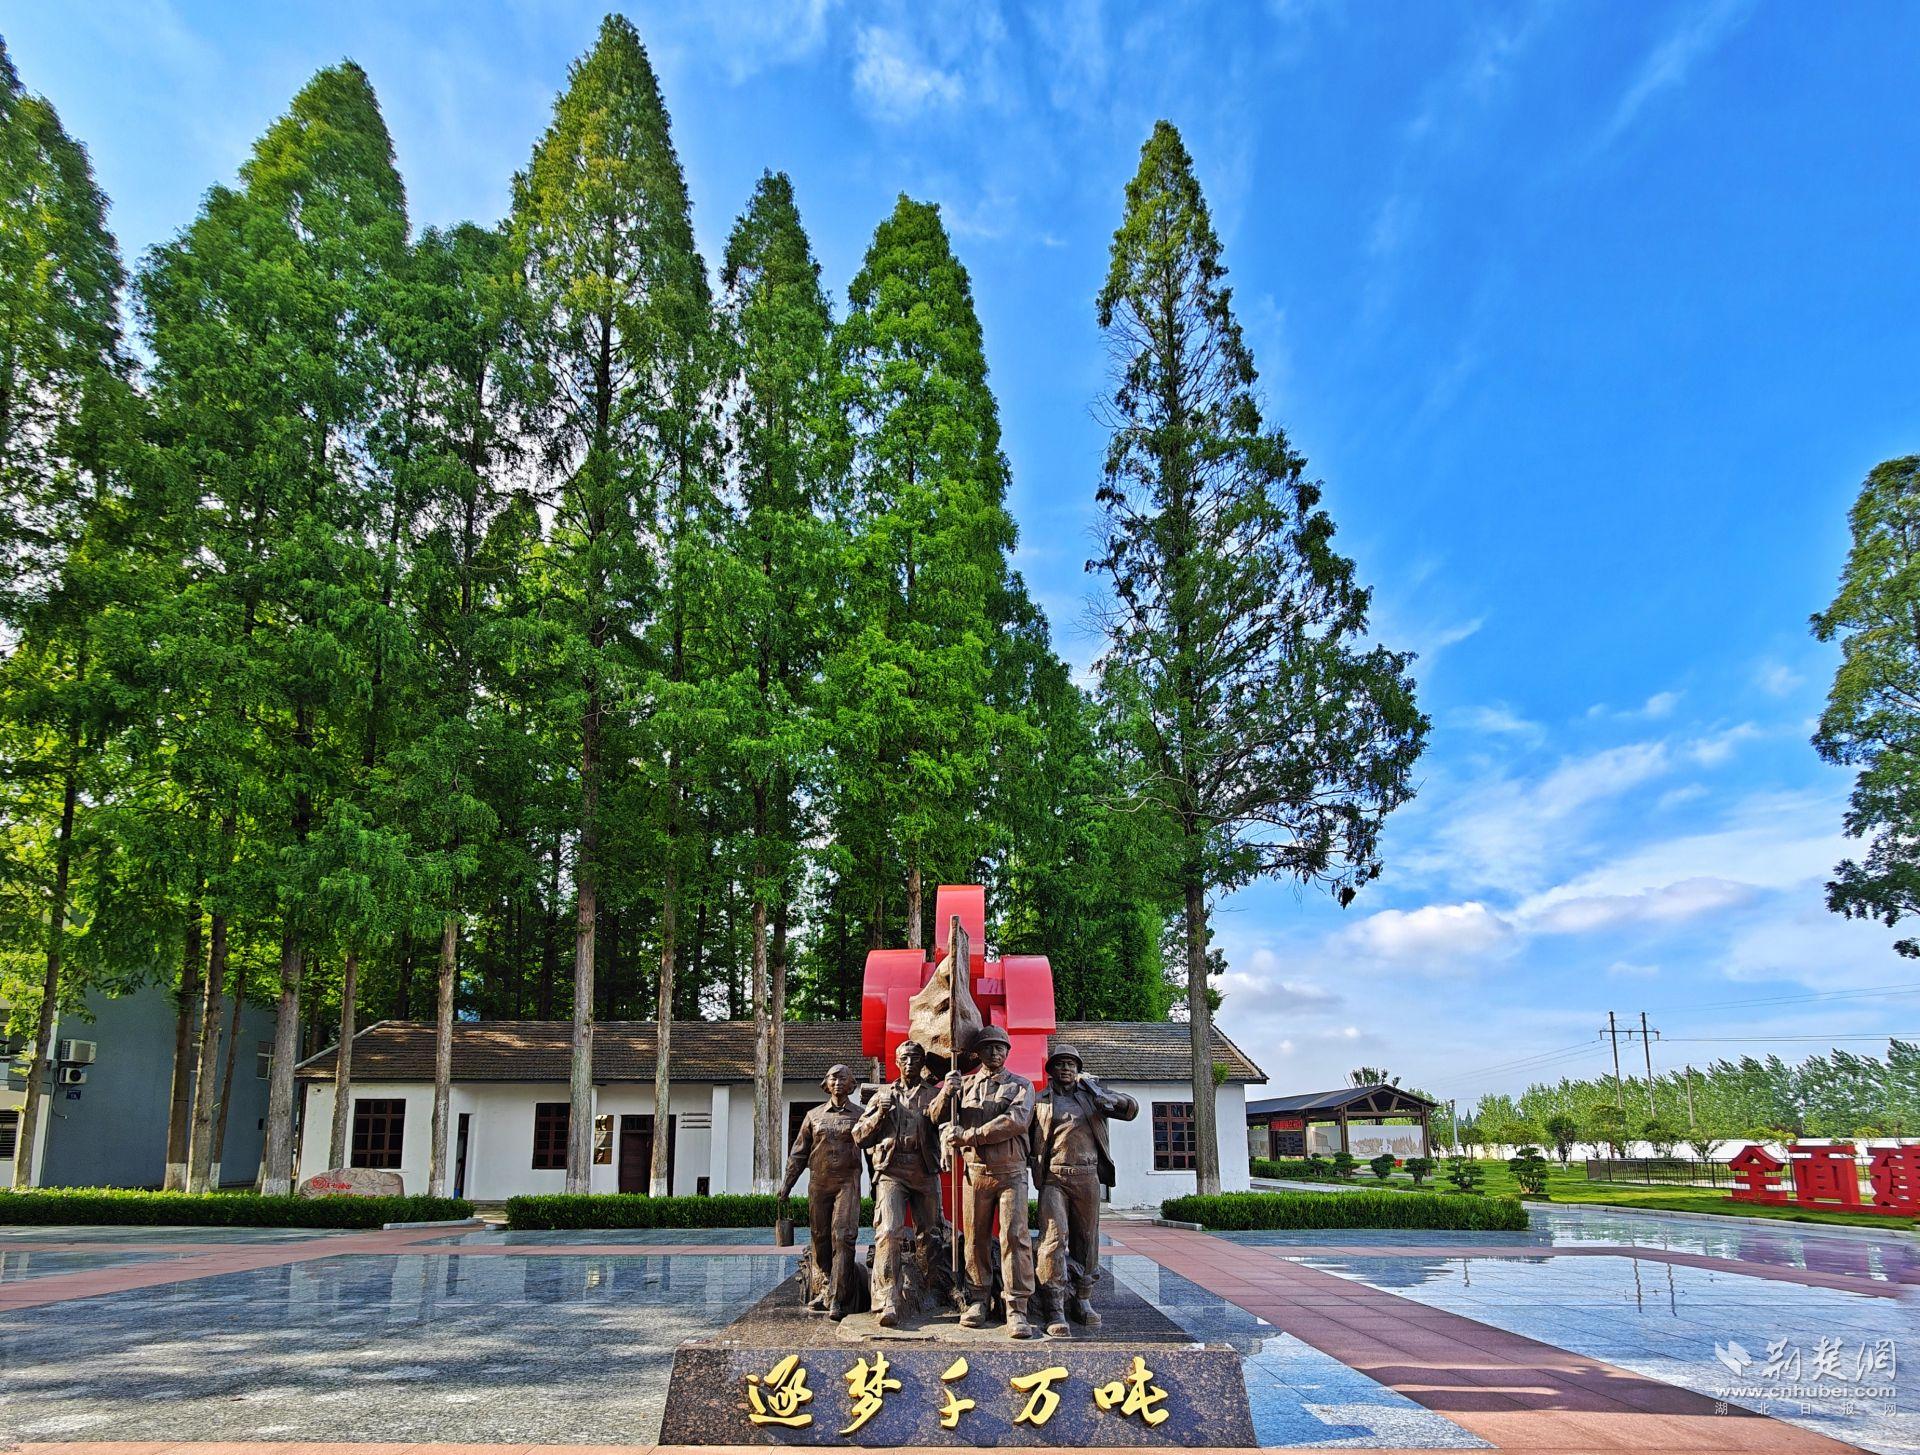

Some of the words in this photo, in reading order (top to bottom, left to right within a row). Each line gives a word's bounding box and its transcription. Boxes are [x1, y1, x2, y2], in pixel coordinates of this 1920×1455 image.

[746, 1351, 1169, 1435] 逐梦千万吨
